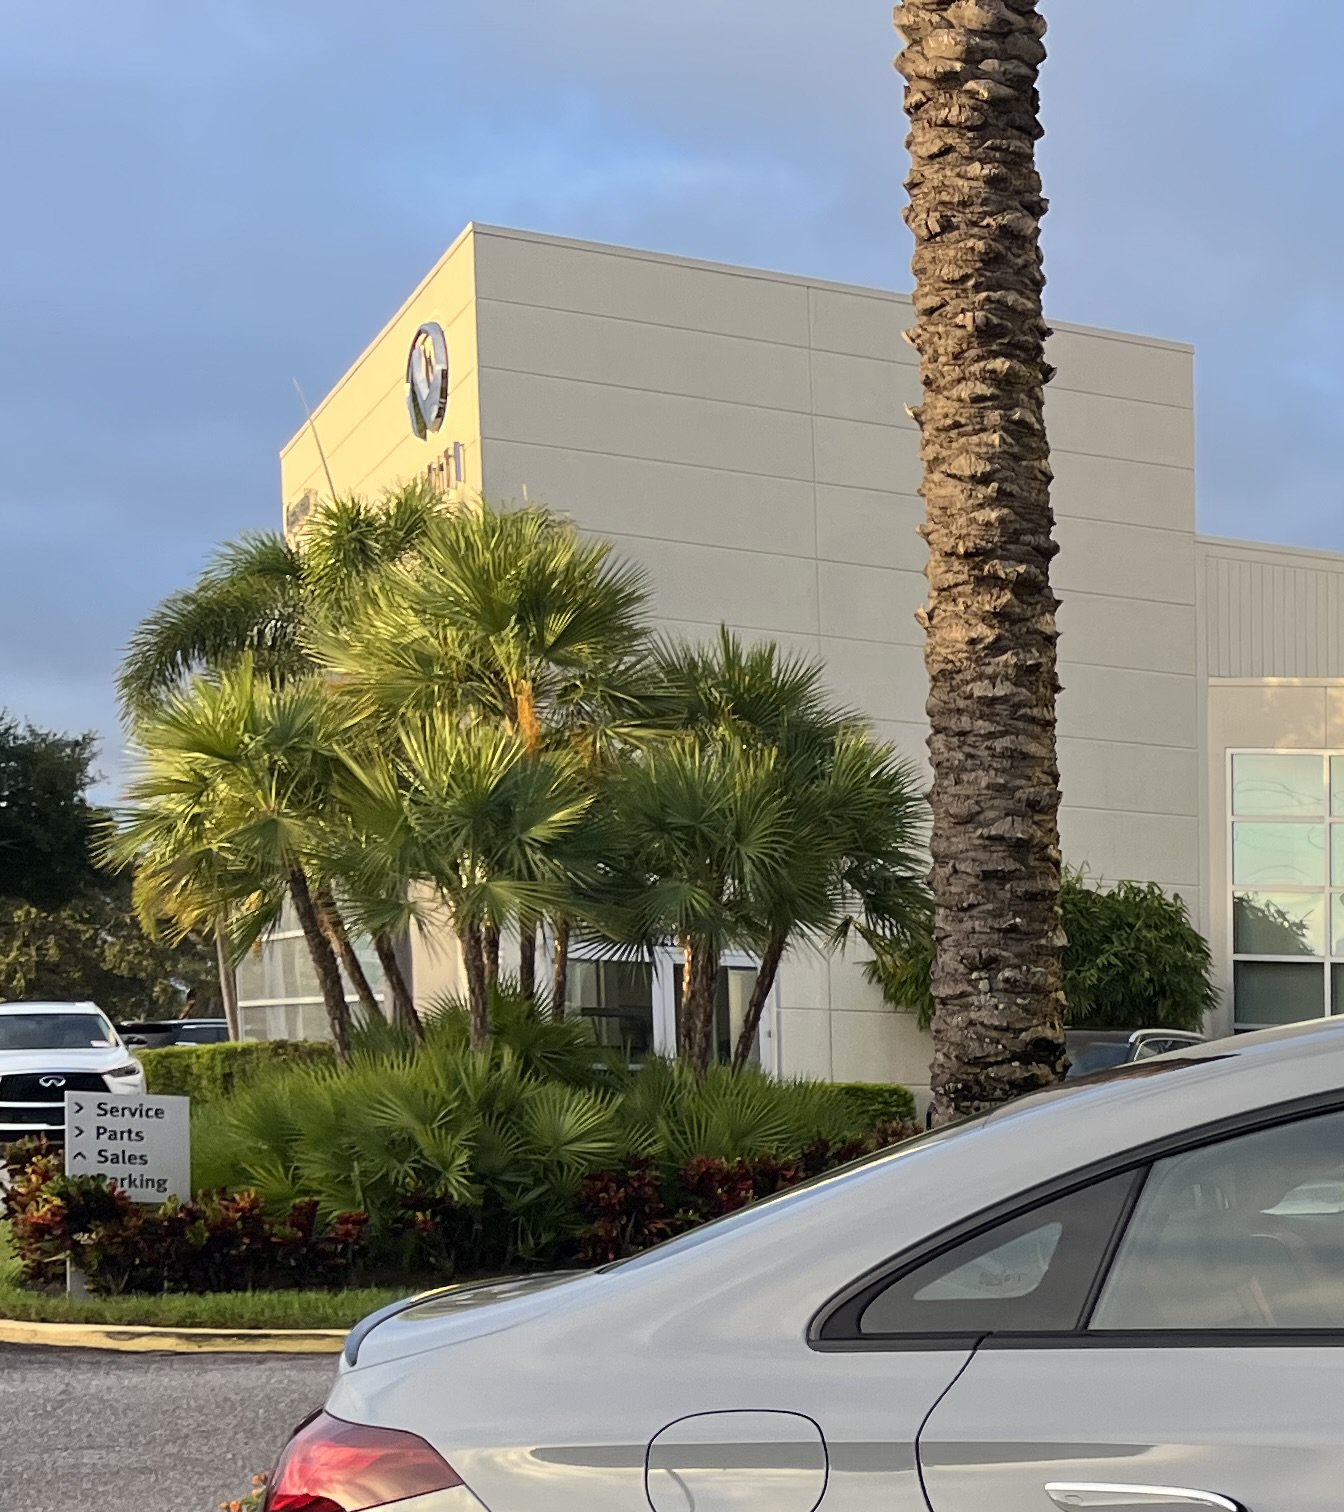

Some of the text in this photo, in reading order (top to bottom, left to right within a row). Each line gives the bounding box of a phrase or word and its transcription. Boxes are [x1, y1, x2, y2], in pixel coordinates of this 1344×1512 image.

[96, 1102, 165, 1120] Service
[96, 1126, 145, 1142] Parts
[97, 1149, 149, 1166] Sales
